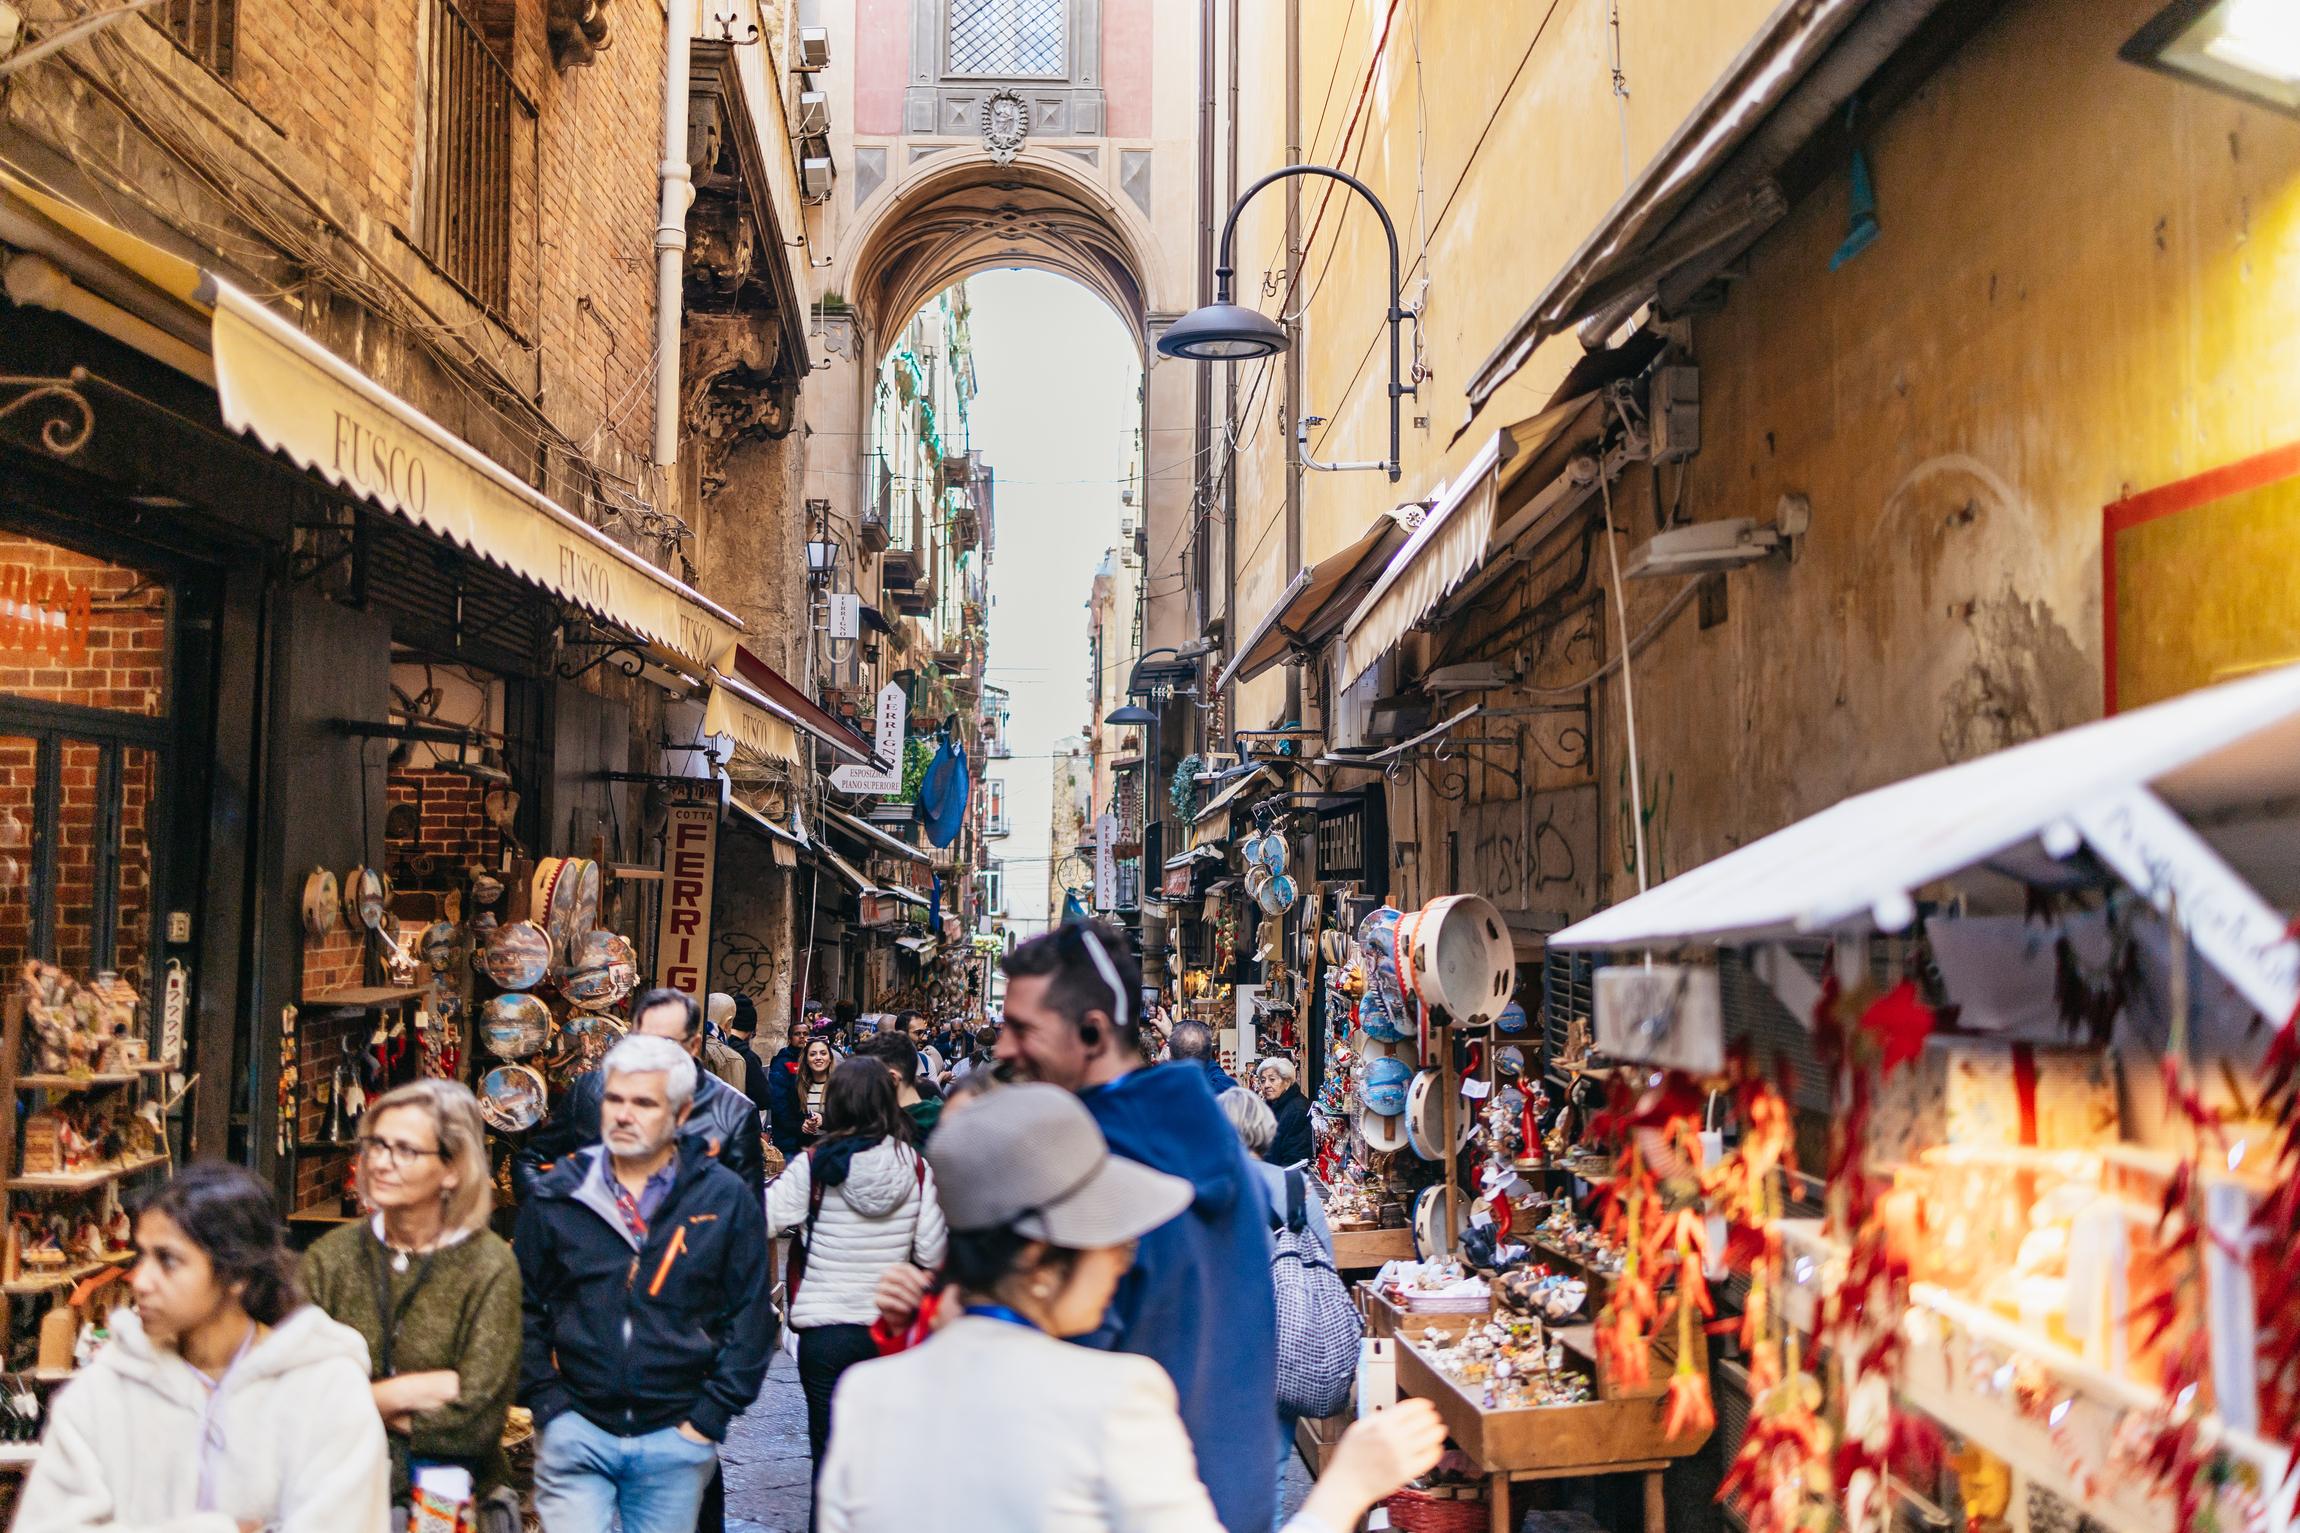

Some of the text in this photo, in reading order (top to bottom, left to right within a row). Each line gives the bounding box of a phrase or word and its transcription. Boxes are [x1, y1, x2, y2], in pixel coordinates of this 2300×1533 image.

[333, 410, 426, 514] FUSCO
[558, 543, 610, 609] FUSCO
[679, 613, 713, 660] FUSCO
[839, 595, 847, 637] FERRIGNO
[742, 712, 768, 746] FUSCO
[841, 779, 900, 791] PIANO SUPERIORE
[849, 768, 893, 779] ESPOSIZIOE
[675, 810, 713, 821] COTTA
[1319, 811, 1361, 871] FERRARA
